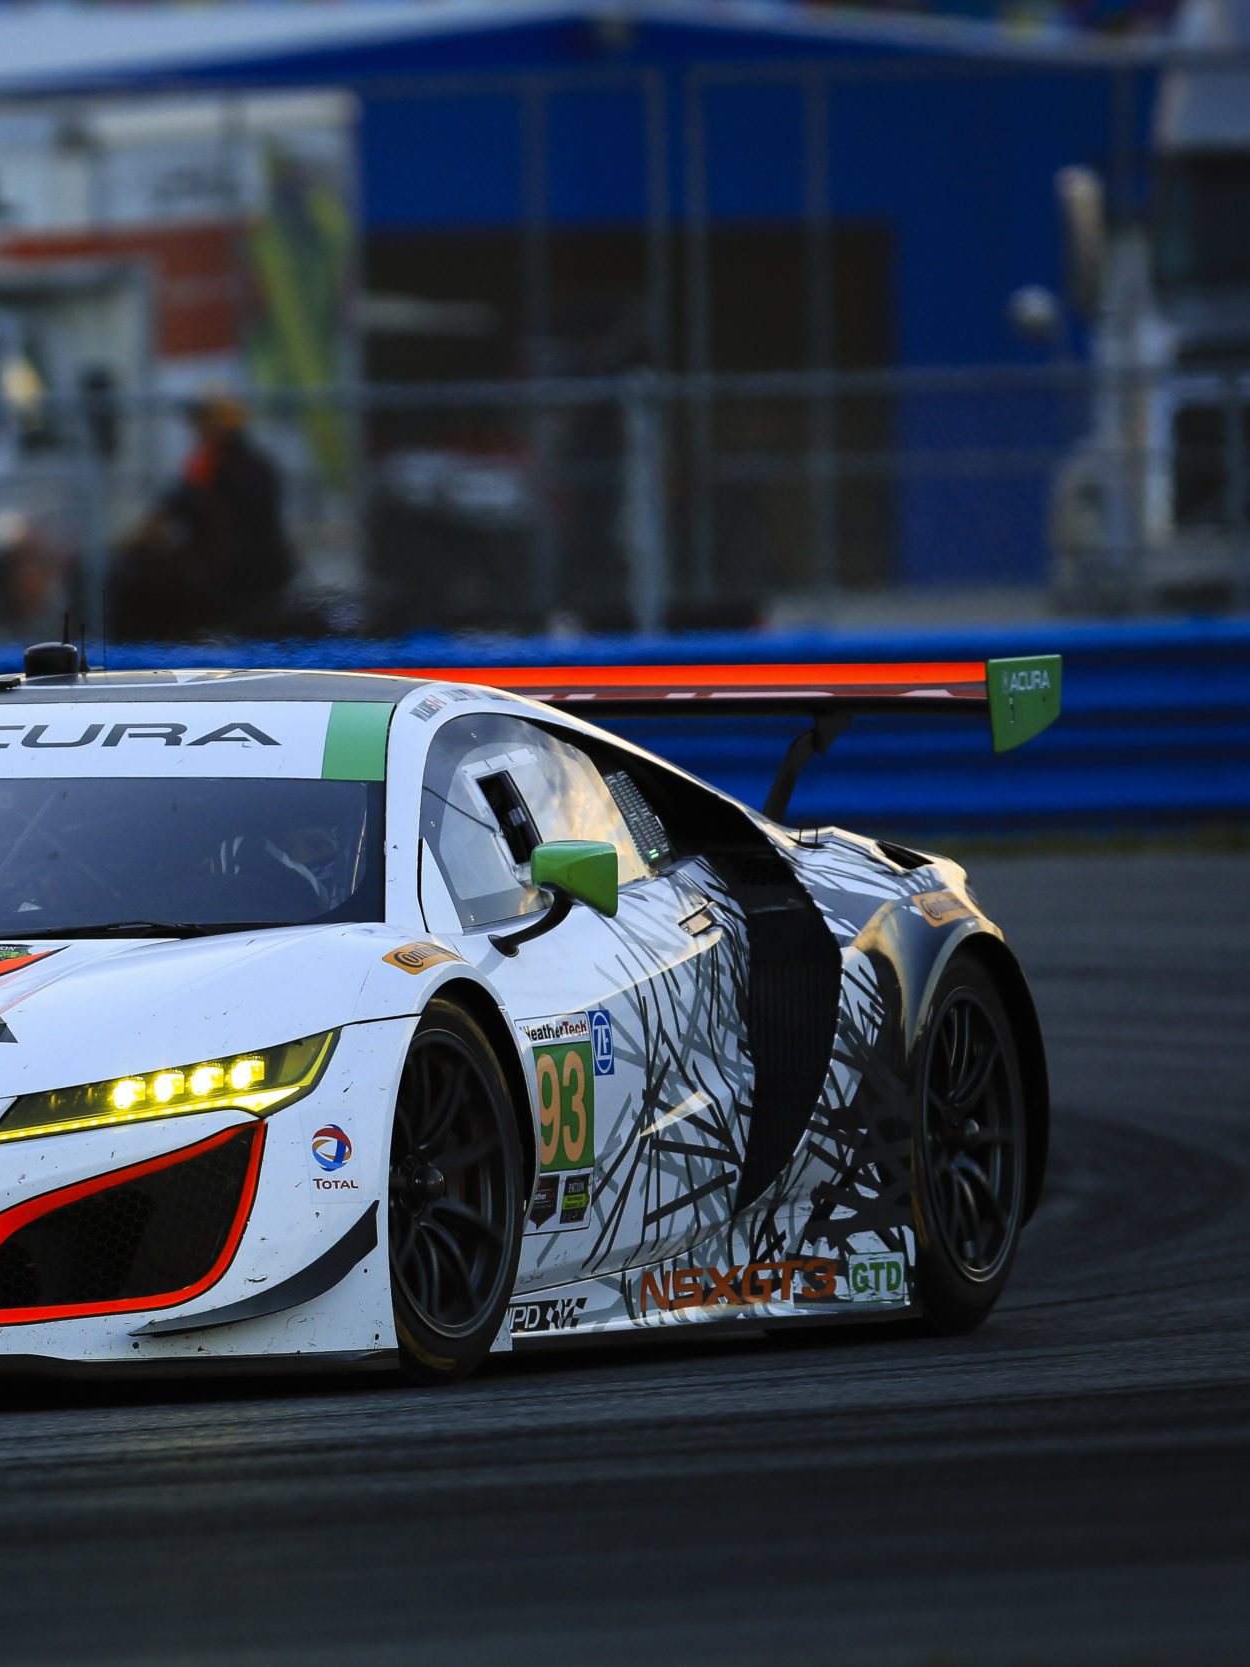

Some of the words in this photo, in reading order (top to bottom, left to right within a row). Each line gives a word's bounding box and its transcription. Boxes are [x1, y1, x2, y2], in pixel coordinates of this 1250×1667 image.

[1010, 670, 1051, 691] ACURA
[594, 1025, 612, 1061] ZF
[536, 1050, 587, 1165] 93
[312, 1178, 359, 1190] TOTAL
[851, 1260, 903, 1294] GTD
[508, 1305, 541, 1330] PD
